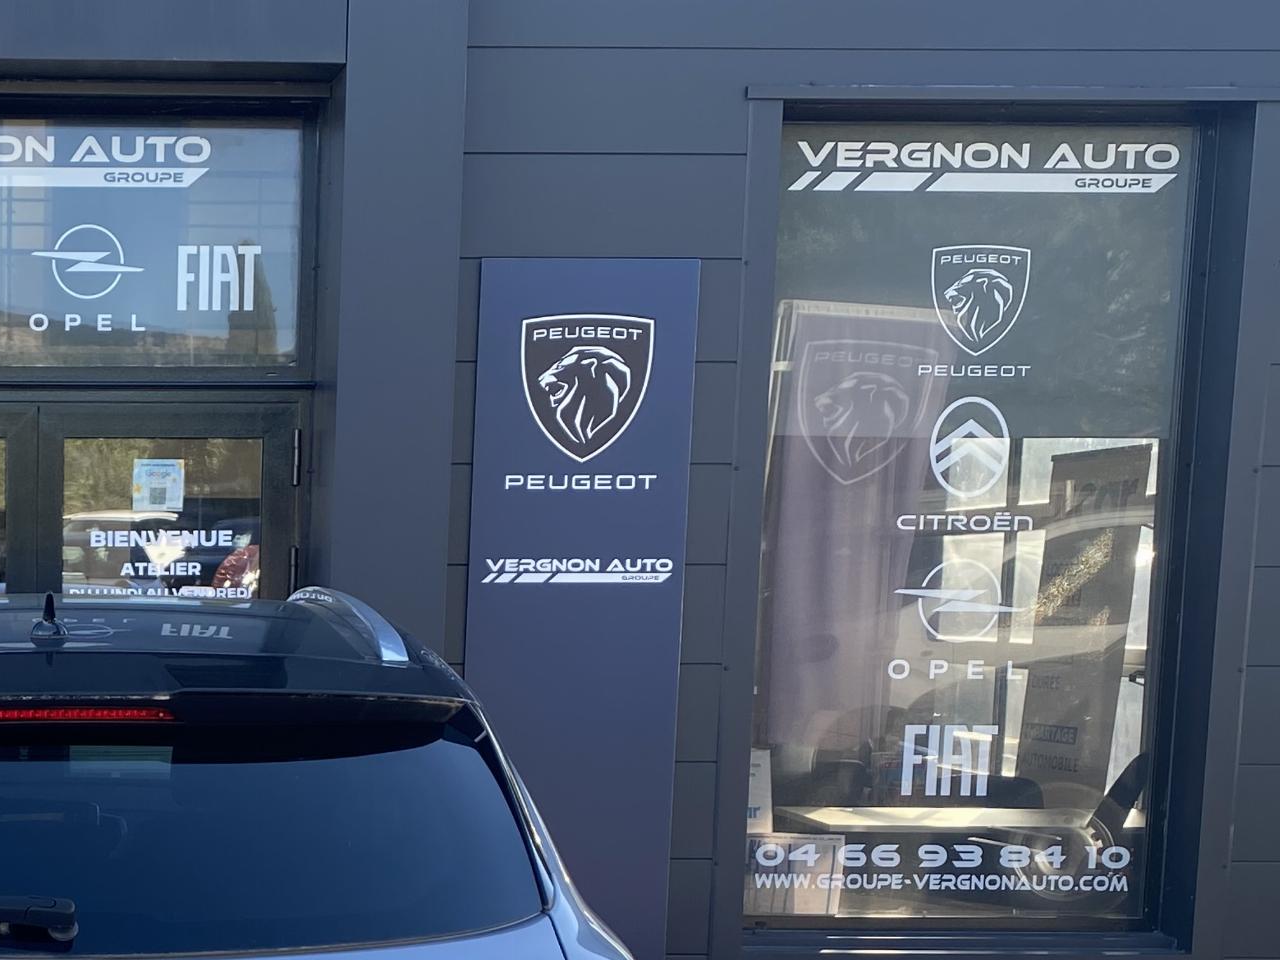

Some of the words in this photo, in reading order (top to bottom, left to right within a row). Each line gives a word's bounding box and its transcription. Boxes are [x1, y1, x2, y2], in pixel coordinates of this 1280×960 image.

[70, 135, 212, 163] AUTO
[797, 141, 1030, 169] VERGNON
[1044, 143, 1180, 169] AUTO
[103, 172, 185, 183] GROUPE
[1074, 178, 1153, 189] GROUPE
[940, 254, 1022, 266] PEUGEOT
[176, 244, 262, 311] FIAT
[29, 314, 146, 331] OPEL
[533, 326, 643, 341] PEUGEOT
[918, 365, 1031, 377] PEUGEOT
[505, 474, 657, 490] PEUGEOT
[896, 512, 1033, 531] CITROËN
[90, 530, 233, 548] BIENVENUE
[120, 562, 201, 576] ATELIER
[486, 558, 600, 572] VERGNON
[606, 559, 673, 572] AUTO
[888, 659, 1024, 680] OPEL
[900, 724, 998, 796] FIAT
[755, 844, 819, 867] 04
[837, 844, 901, 868] 66
[918, 844, 984, 868] 93
[999, 844, 1067, 868] 84
[1084, 844, 1131, 869] 10
[754, 872, 1128, 891] WWW.GROUPE-VERGNONAUTO.COM
